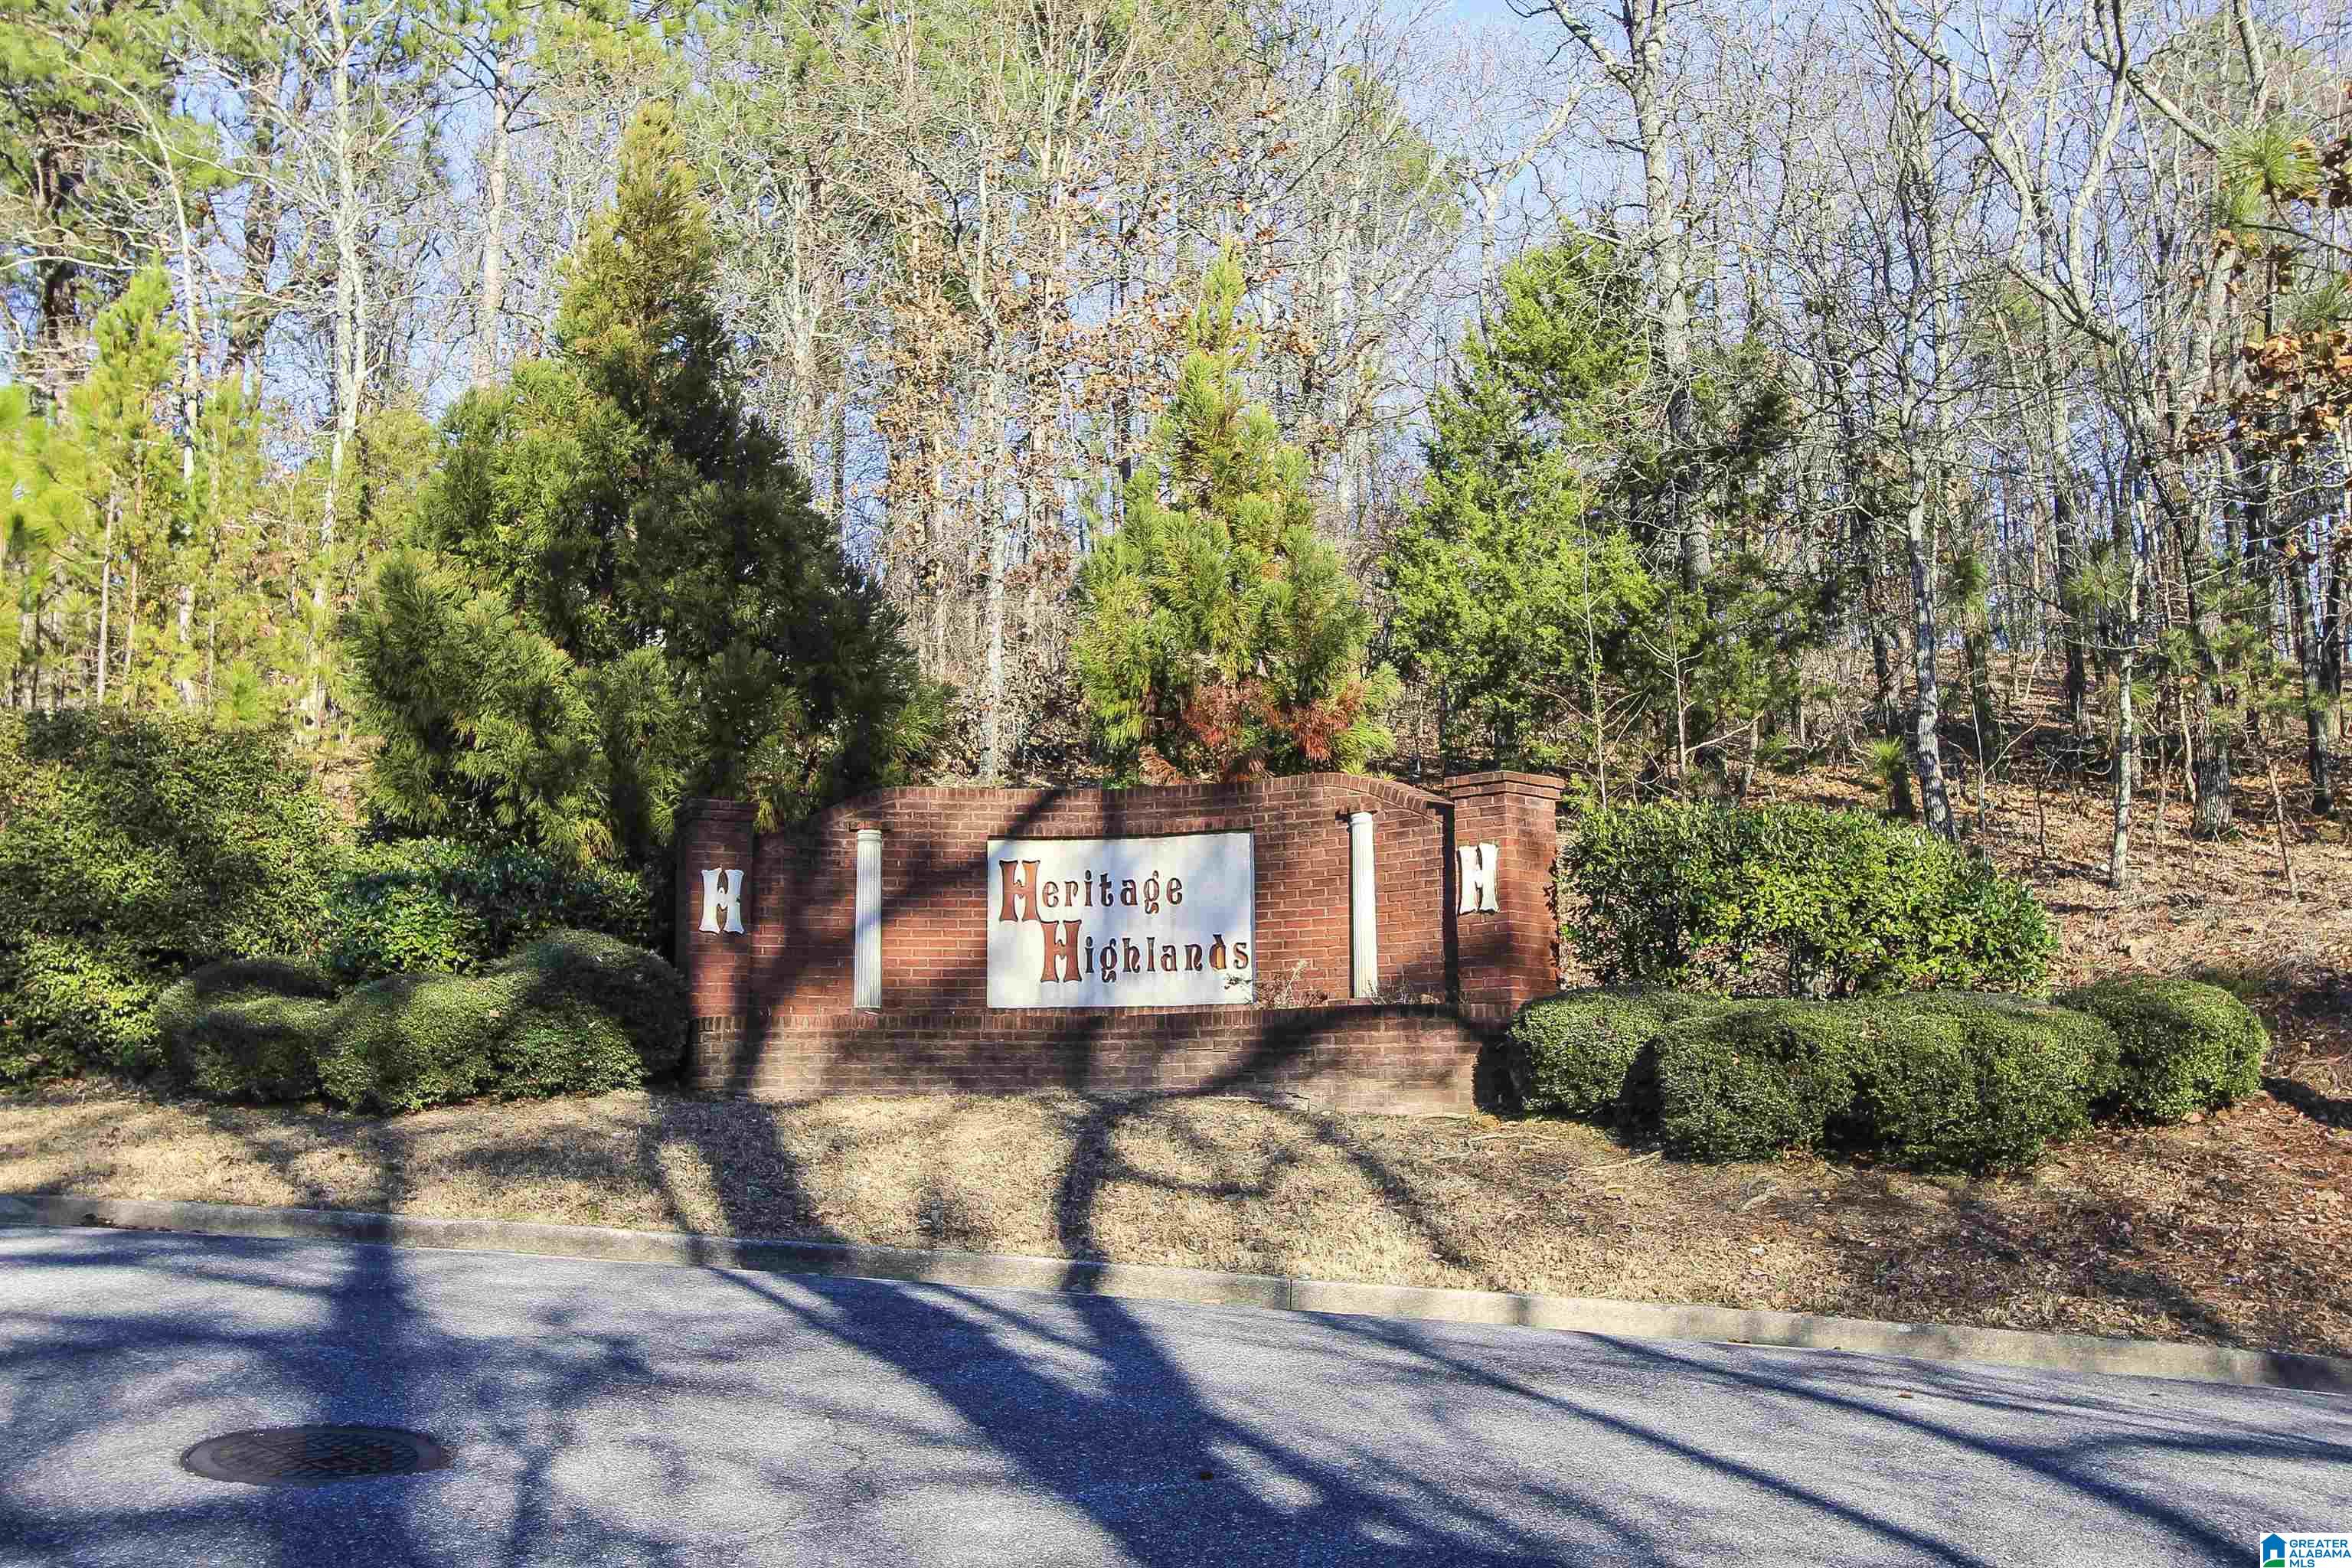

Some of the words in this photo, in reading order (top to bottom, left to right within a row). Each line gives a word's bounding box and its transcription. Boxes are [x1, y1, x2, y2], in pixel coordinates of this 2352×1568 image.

[698, 867, 745, 934] H
[998, 859, 1183, 923] Heritage
[1458, 842, 1500, 914] H
[1040, 919, 1250, 983] Highlands
